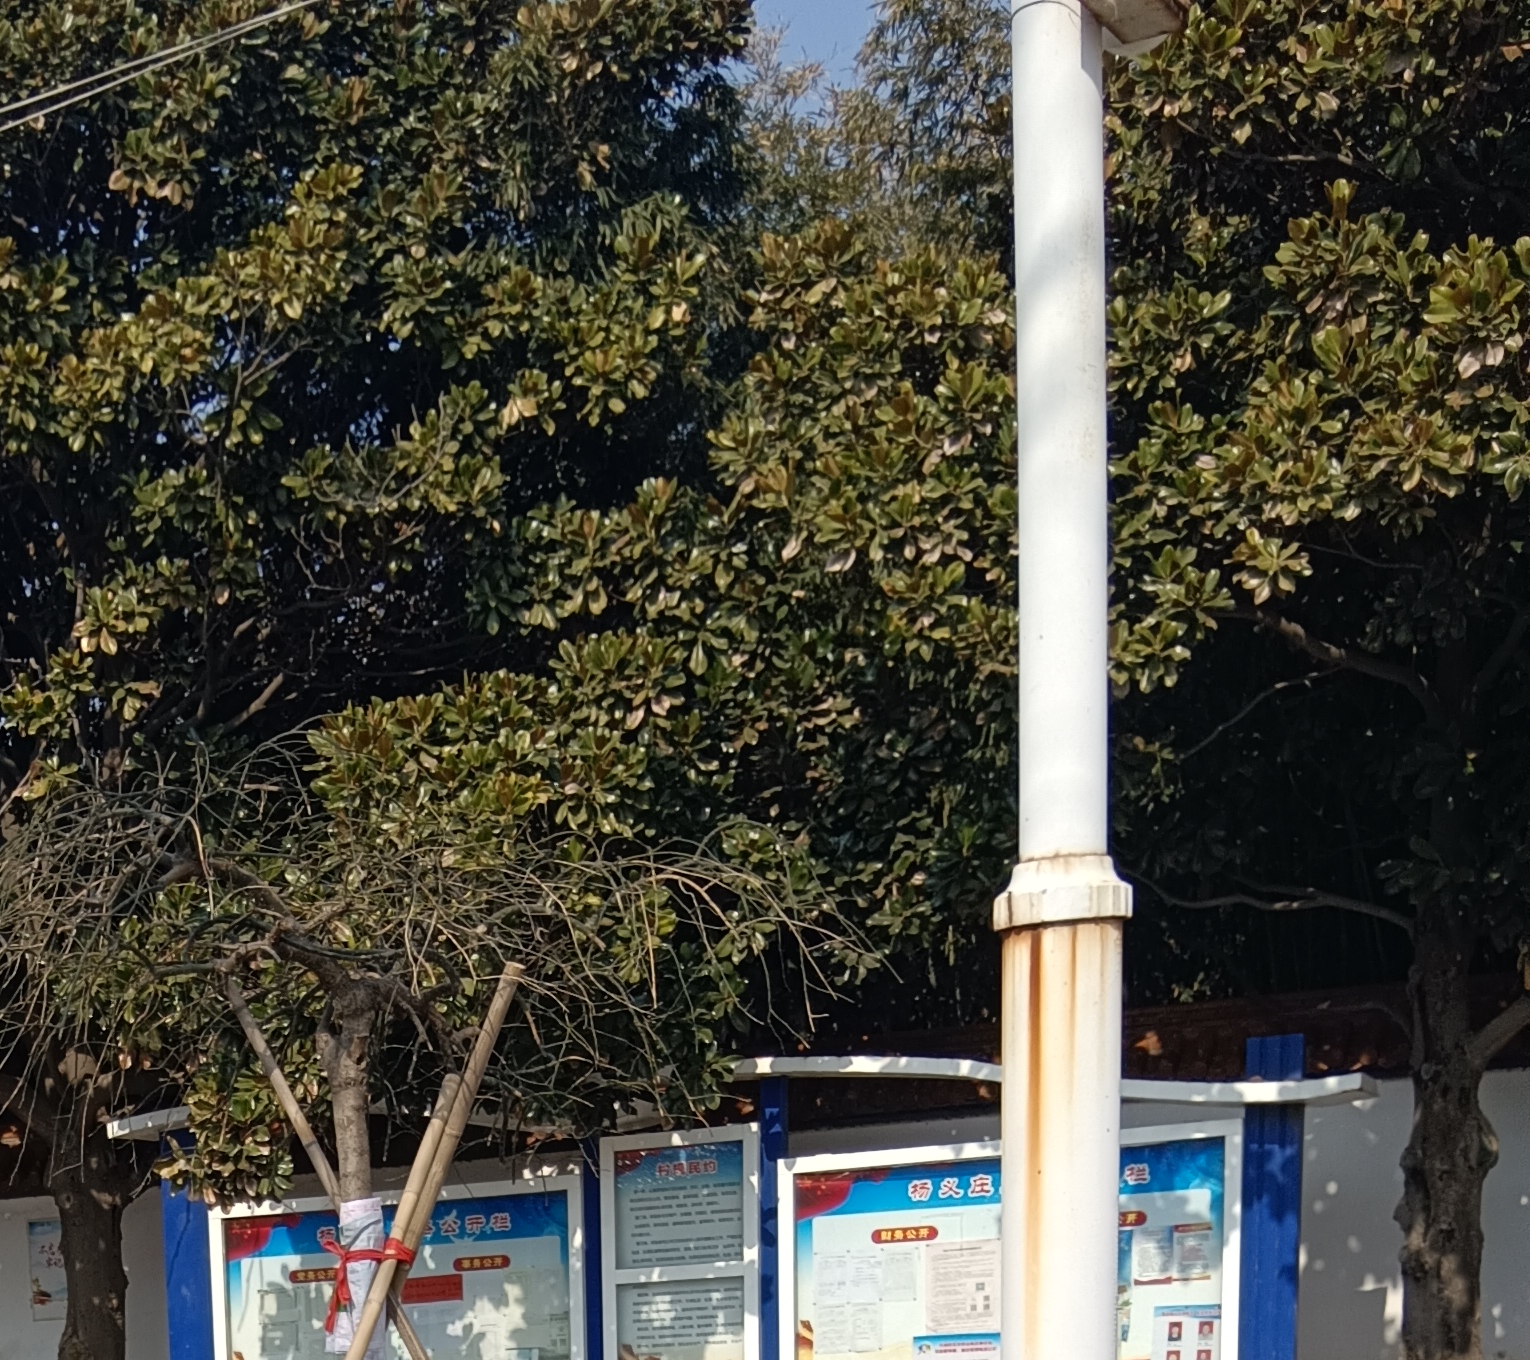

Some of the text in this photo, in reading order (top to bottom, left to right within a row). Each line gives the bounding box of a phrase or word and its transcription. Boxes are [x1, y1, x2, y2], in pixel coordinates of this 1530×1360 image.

[657, 1158, 718, 1177] 村规民约
[908, 1163, 1151, 1202] 杨义庄 栏
[880, 1227, 930, 1242] 财务公开
